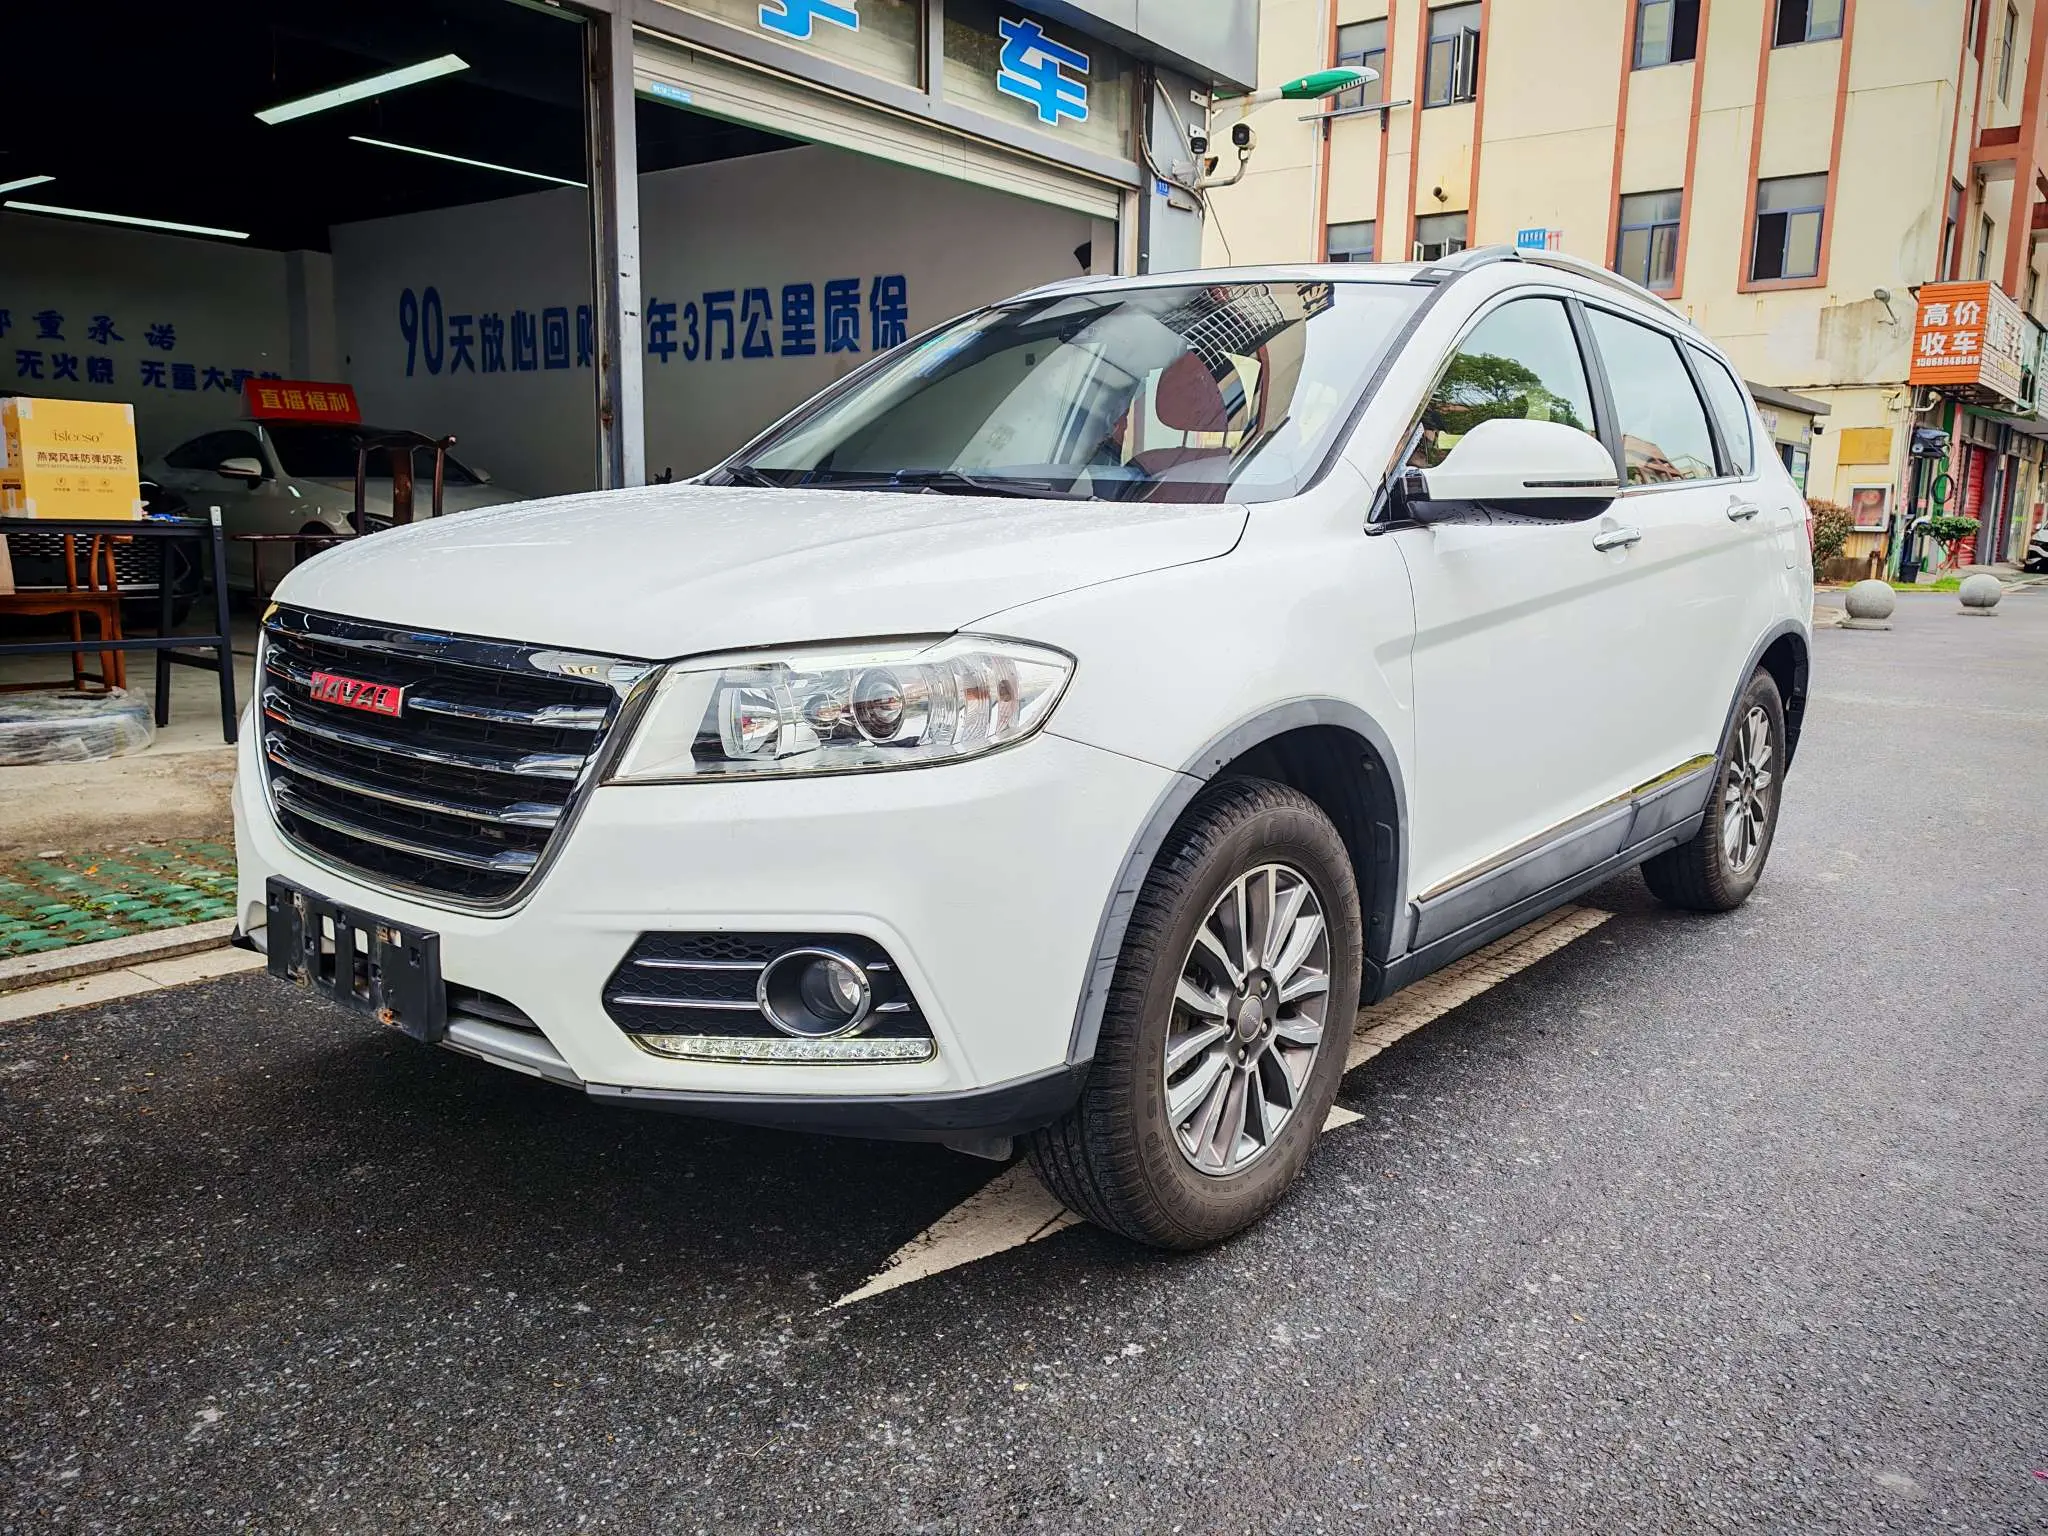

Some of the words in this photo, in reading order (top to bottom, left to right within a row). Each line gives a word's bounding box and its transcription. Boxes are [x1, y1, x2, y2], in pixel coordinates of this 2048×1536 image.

[646, 274, 909, 363] 年3万公里质保
[1923, 301, 1981, 327] 高价
[1920, 330, 1978, 356] 收车
[15, 350, 114, 384] 无火烧
[258, 389, 350, 412] 直播福利
[37, 451, 123, 464] 燕窝风味防弹奶茶
[311, 677, 395, 712] HAVAL
